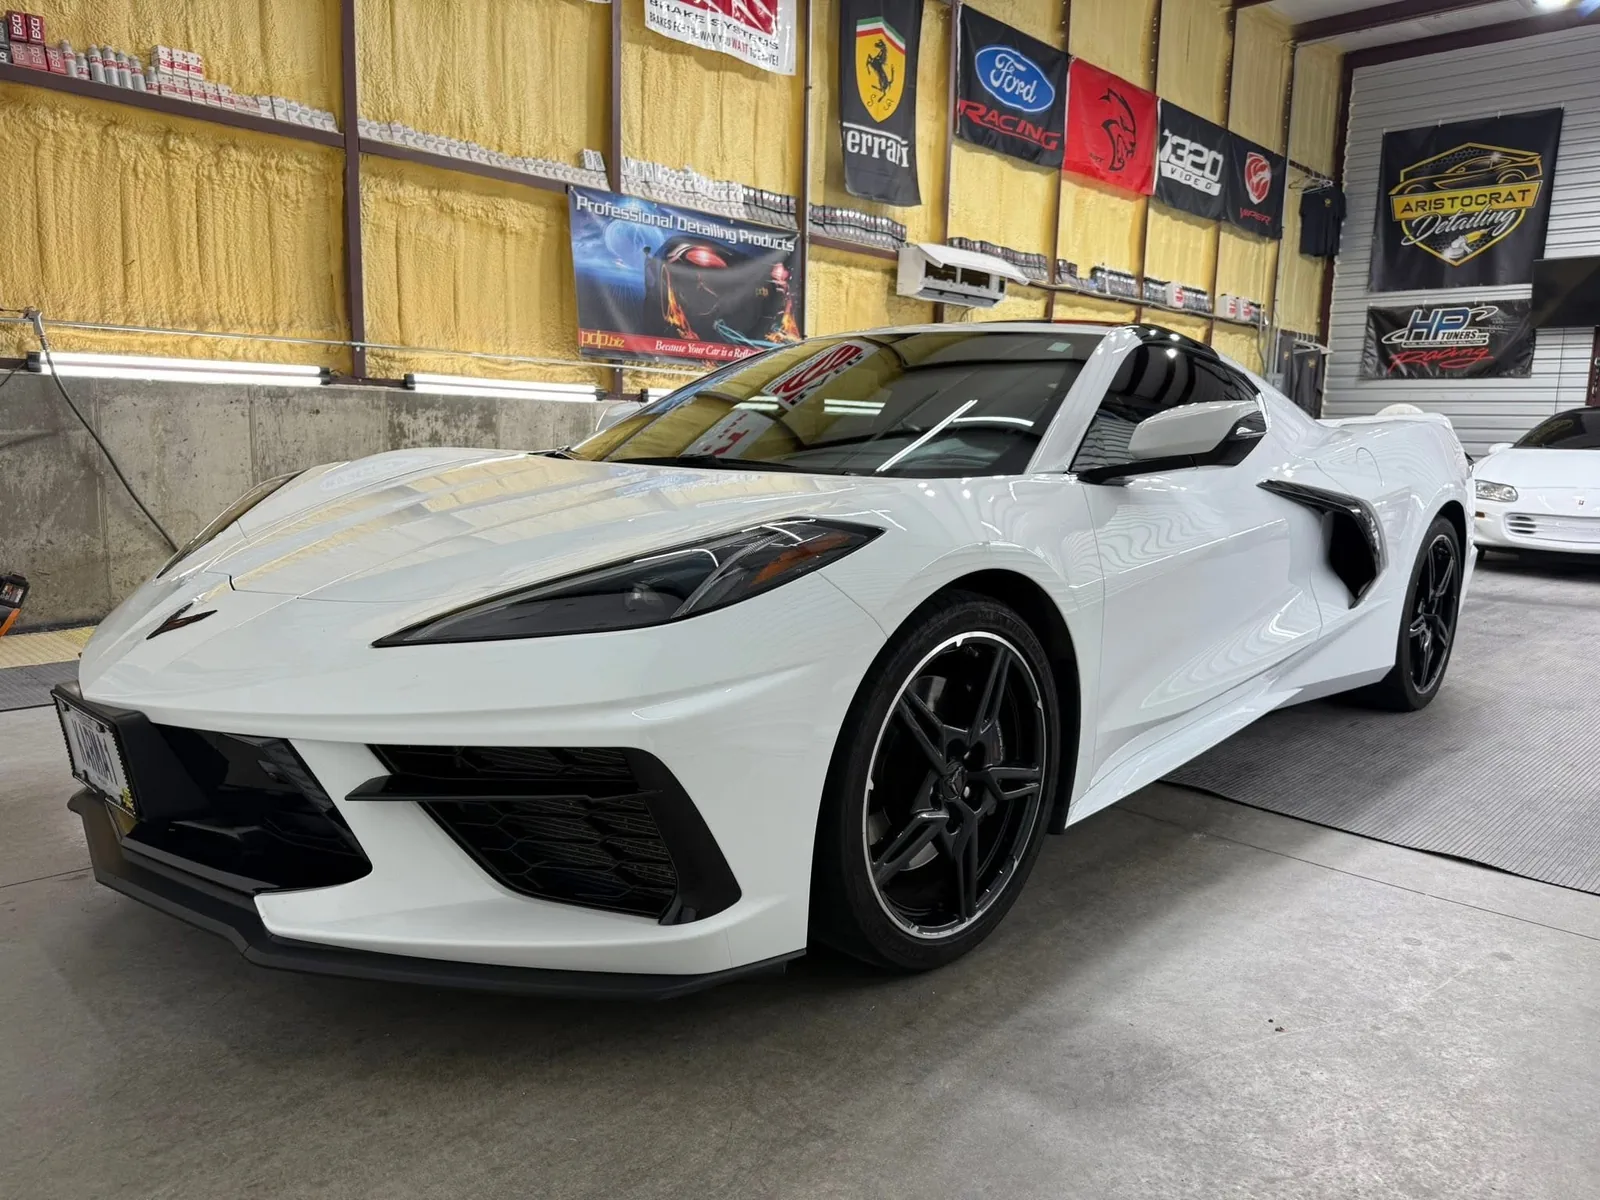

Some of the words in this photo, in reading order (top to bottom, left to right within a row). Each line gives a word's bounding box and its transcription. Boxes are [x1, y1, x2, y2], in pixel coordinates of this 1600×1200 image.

[12, 13, 23, 35] EXO
[30, 16, 41, 40] EXO
[990, 54, 1037, 103] Ford
[957, 99, 1062, 150] RACING
[1170, 167, 1212, 190] VIDEO
[1401, 189, 1531, 214] ARISTOCRAT
[576, 195, 673, 229] Professional
[677, 216, 737, 244] Detailing
[739, 229, 795, 252] Products
[1240, 207, 1271, 226] VIPER
[1401, 203, 1517, 246] Detailing
[1407, 307, 1471, 341] HP
[655, 340, 686, 353] Because
[688, 343, 705, 355] Your
[706, 345, 721, 356] Car
[721, 347, 728, 357] is
[1387, 346, 1494, 376] Racing
